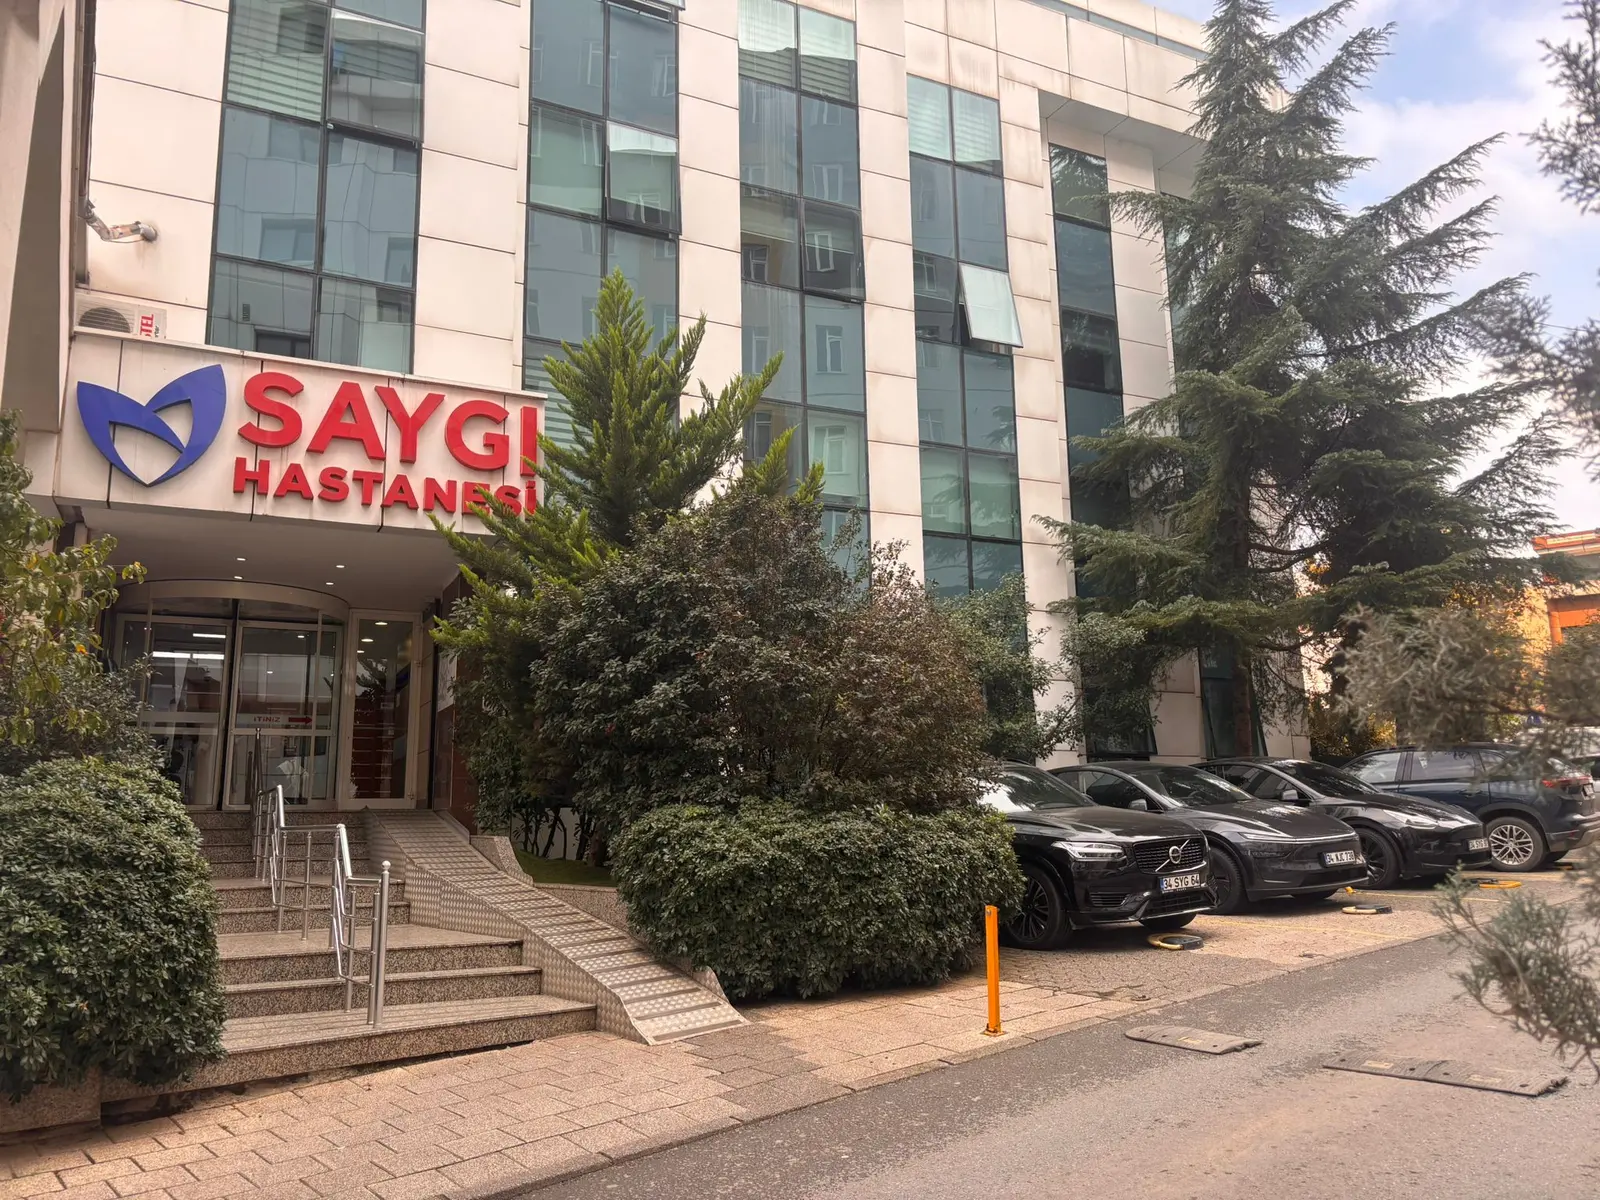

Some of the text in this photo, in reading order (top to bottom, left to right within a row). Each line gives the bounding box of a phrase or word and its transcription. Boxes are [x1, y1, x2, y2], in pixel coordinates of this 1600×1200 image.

[238, 371, 538, 477] SAYGI
[1163, 874, 1199, 889] 34 SYG 64
